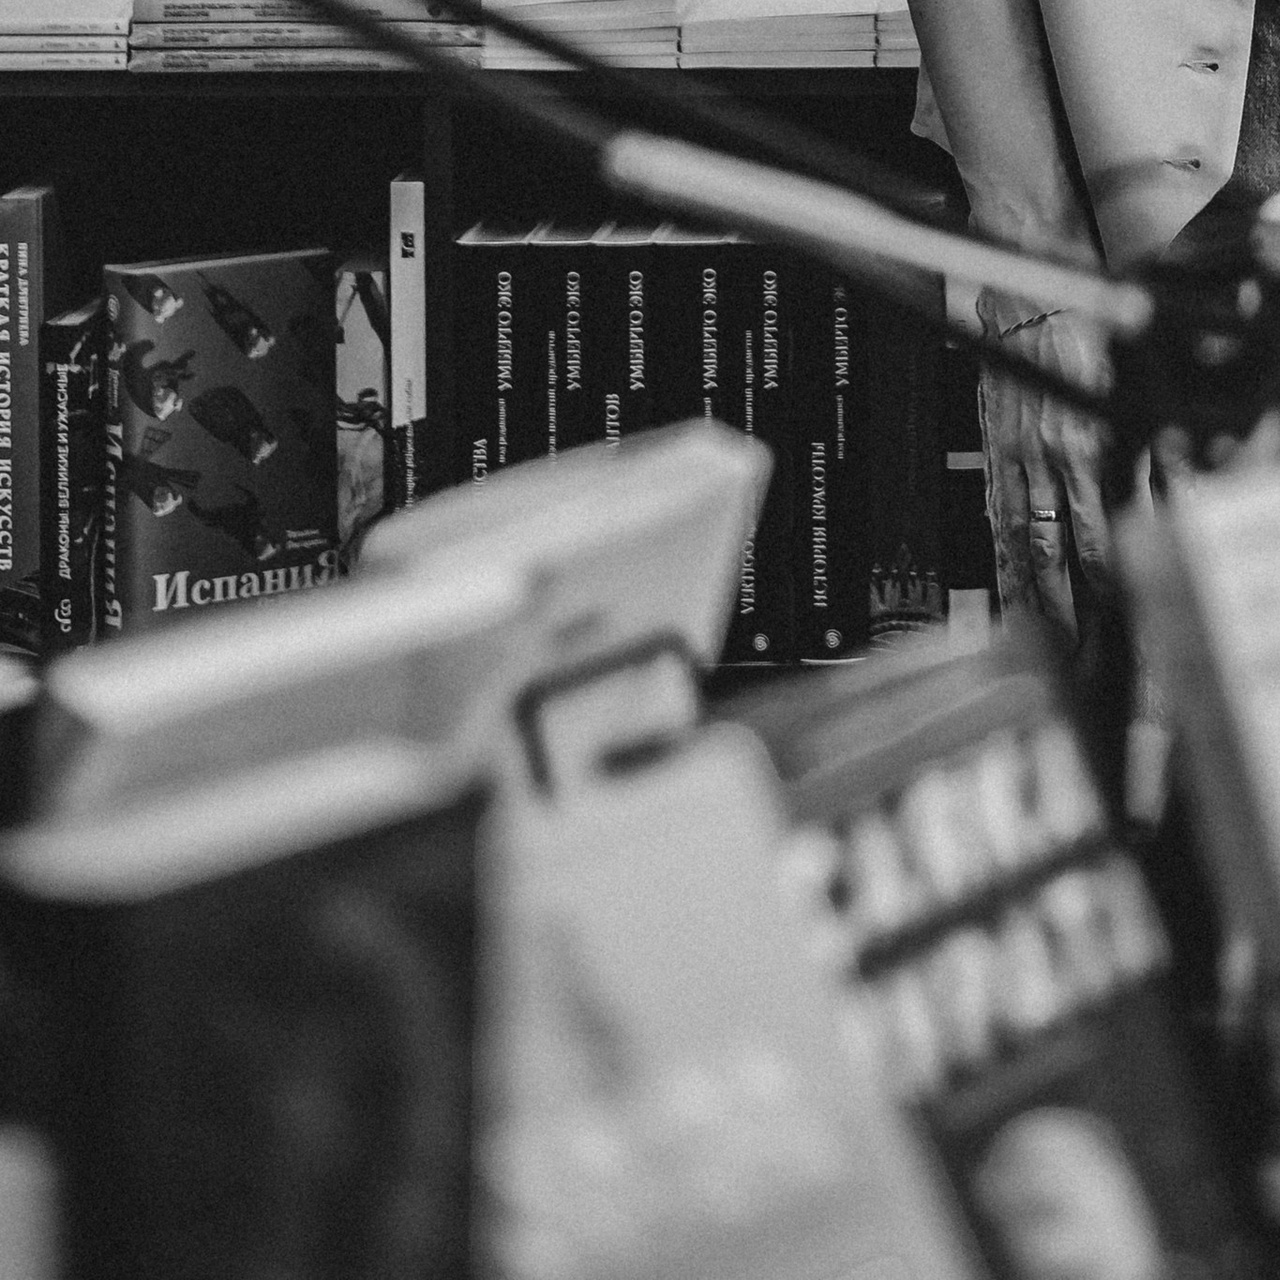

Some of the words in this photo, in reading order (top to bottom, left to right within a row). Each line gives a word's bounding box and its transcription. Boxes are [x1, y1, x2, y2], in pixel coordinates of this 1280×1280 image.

[18, 242, 29, 276] НИНА
[498, 271, 512, 308] ЭКО
[567, 271, 581, 308] ЭКО
[629, 271, 644, 308] ЭКО
[702, 268, 717, 305] ЭКО
[764, 271, 778, 308] ЭКО
[17, 277, 29, 346] ДМИТРИЕВА
[498, 311, 513, 392] УМБЕРТО
[567, 311, 582, 391] УМБЕРТО
[629, 311, 645, 391] УМБЕРТО
[702, 309, 718, 391] УМБЕРТО
[764, 311, 779, 391] УМБЕРТО
[834, 307, 849, 387] УМБЕРТО
[54, 363, 68, 432] УЖАСНЫЕ
[605, 393, 621, 450] АНТОВ
[56, 445, 70, 509] ВЕЛИКИЕ
[472, 438, 487, 484] СТВА
[811, 441, 827, 521] КРАСОТЫ
[151, 548, 348, 612] Испания
[812, 526, 828, 608] ИСТОРИЯ
